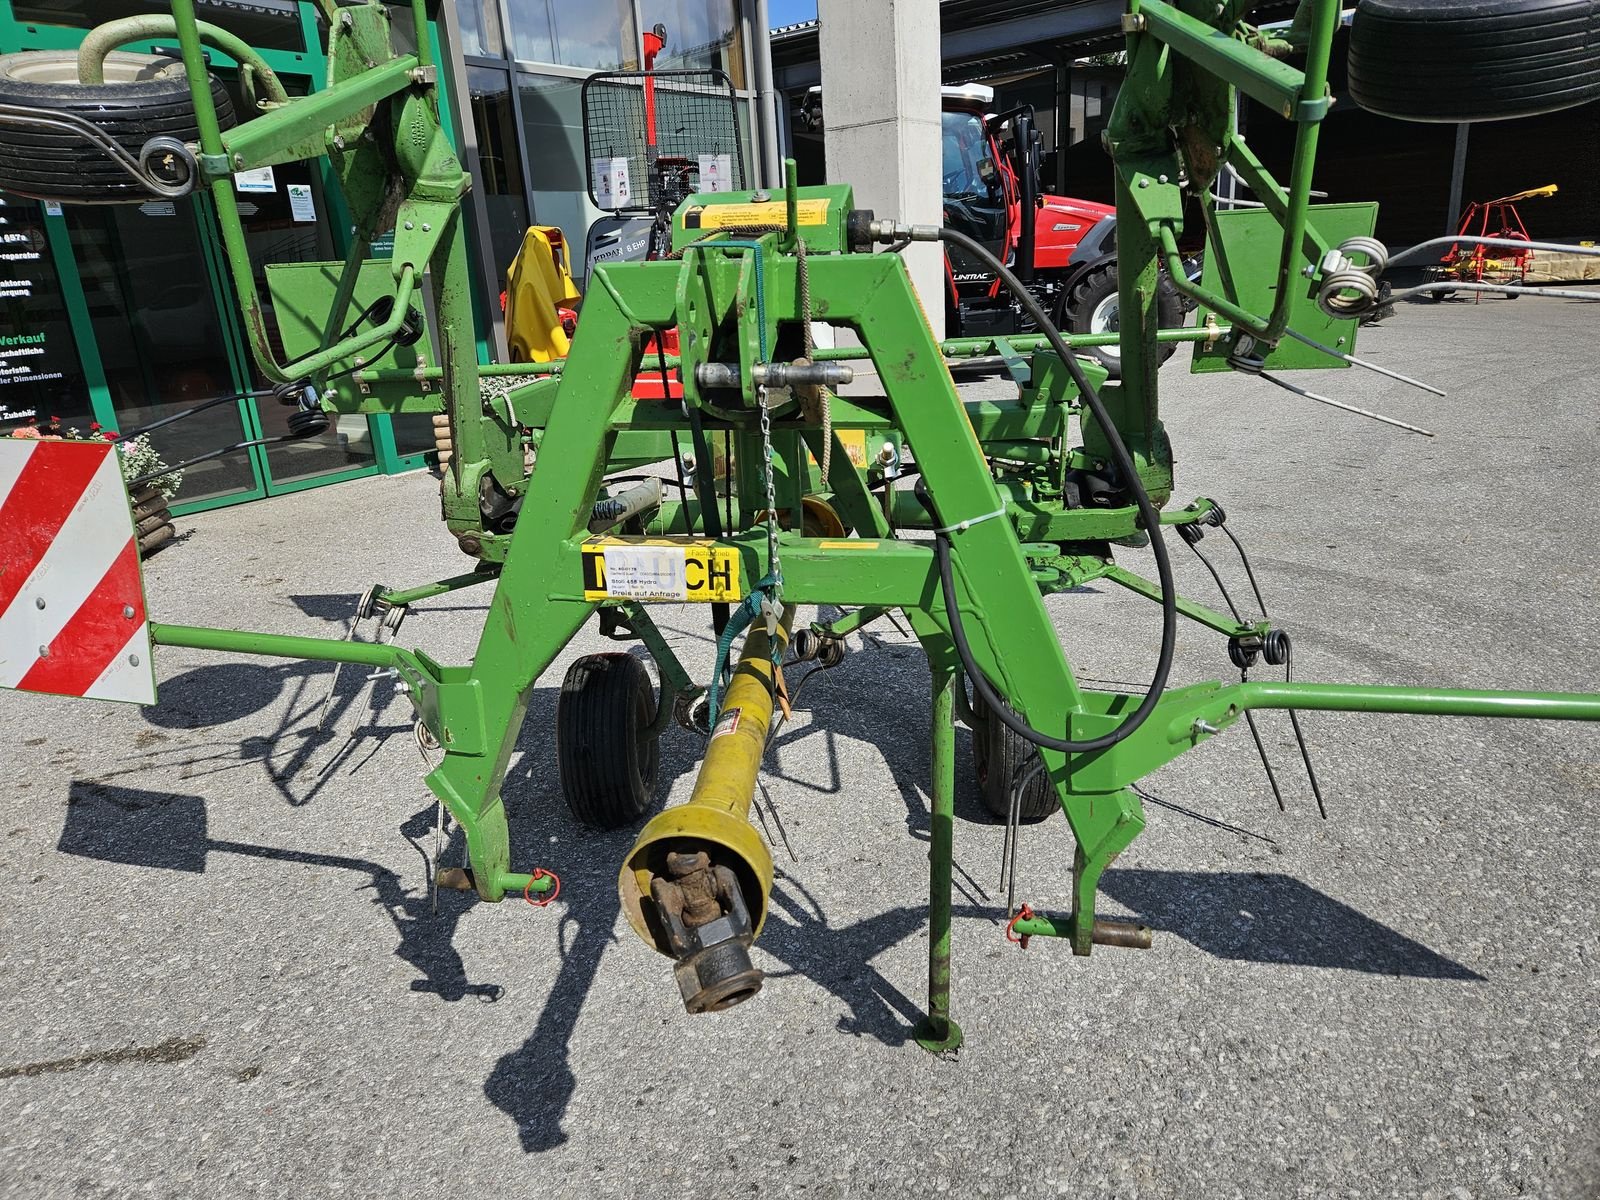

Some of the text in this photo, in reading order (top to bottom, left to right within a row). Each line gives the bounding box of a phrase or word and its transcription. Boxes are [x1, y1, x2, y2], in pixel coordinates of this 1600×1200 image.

[631, 239, 646, 251] EHP
[13, 372, 63, 383] Dimensionen
[3, 409, 36, 420] Zubehör
[649, 590, 681, 599] Anfrage
